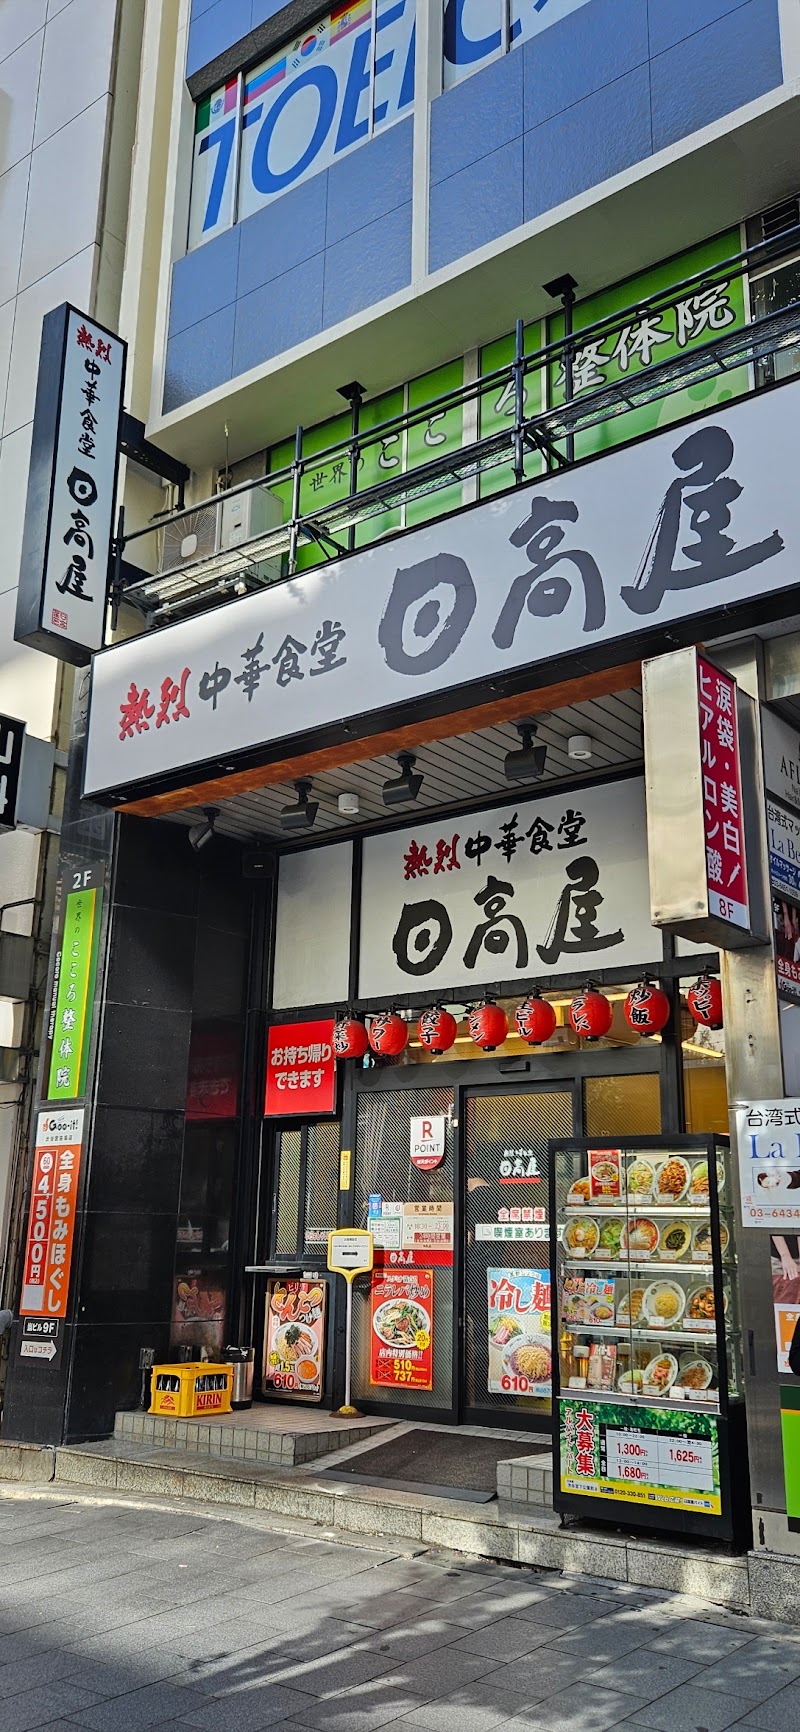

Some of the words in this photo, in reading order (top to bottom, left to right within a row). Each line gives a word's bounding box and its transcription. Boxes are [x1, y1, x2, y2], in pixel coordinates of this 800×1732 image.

[76, 324, 112, 365] 熱烈
[78, 358, 101, 460] 中華食堂
[56, 465, 98, 602] 日高屋
[378, 426, 786, 676] 日高屋
[698, 664, 724, 885] ヒアルロン酸
[715, 678, 741, 856] 涙袋・美白
[770, 828, 785, 855] La
[72, 870, 92, 889] 2F
[392, 856, 625, 976] 日高屋
[719, 898, 734, 919] 8F
[56, 940, 81, 1088] こころ整体院
[629, 988, 653, 1026] 炒飯
[420, 1010, 450, 1046] 餃子
[271, 1043, 332, 1066] お持ち帰り
[275, 1068, 326, 1090] できます
[422, 1120, 434, 1139] R
[746, 1107, 800, 1127] 台湾式
[414, 1143, 441, 1153] POINT
[750, 1133, 785, 1159] La
[47, 1149, 75, 1312] 全身もみほぐし
[499, 1208, 544, 1220] 全席禁煙
[196, 1392, 223, 1406] KIRIN
[575, 1408, 596, 1476] 大募集
